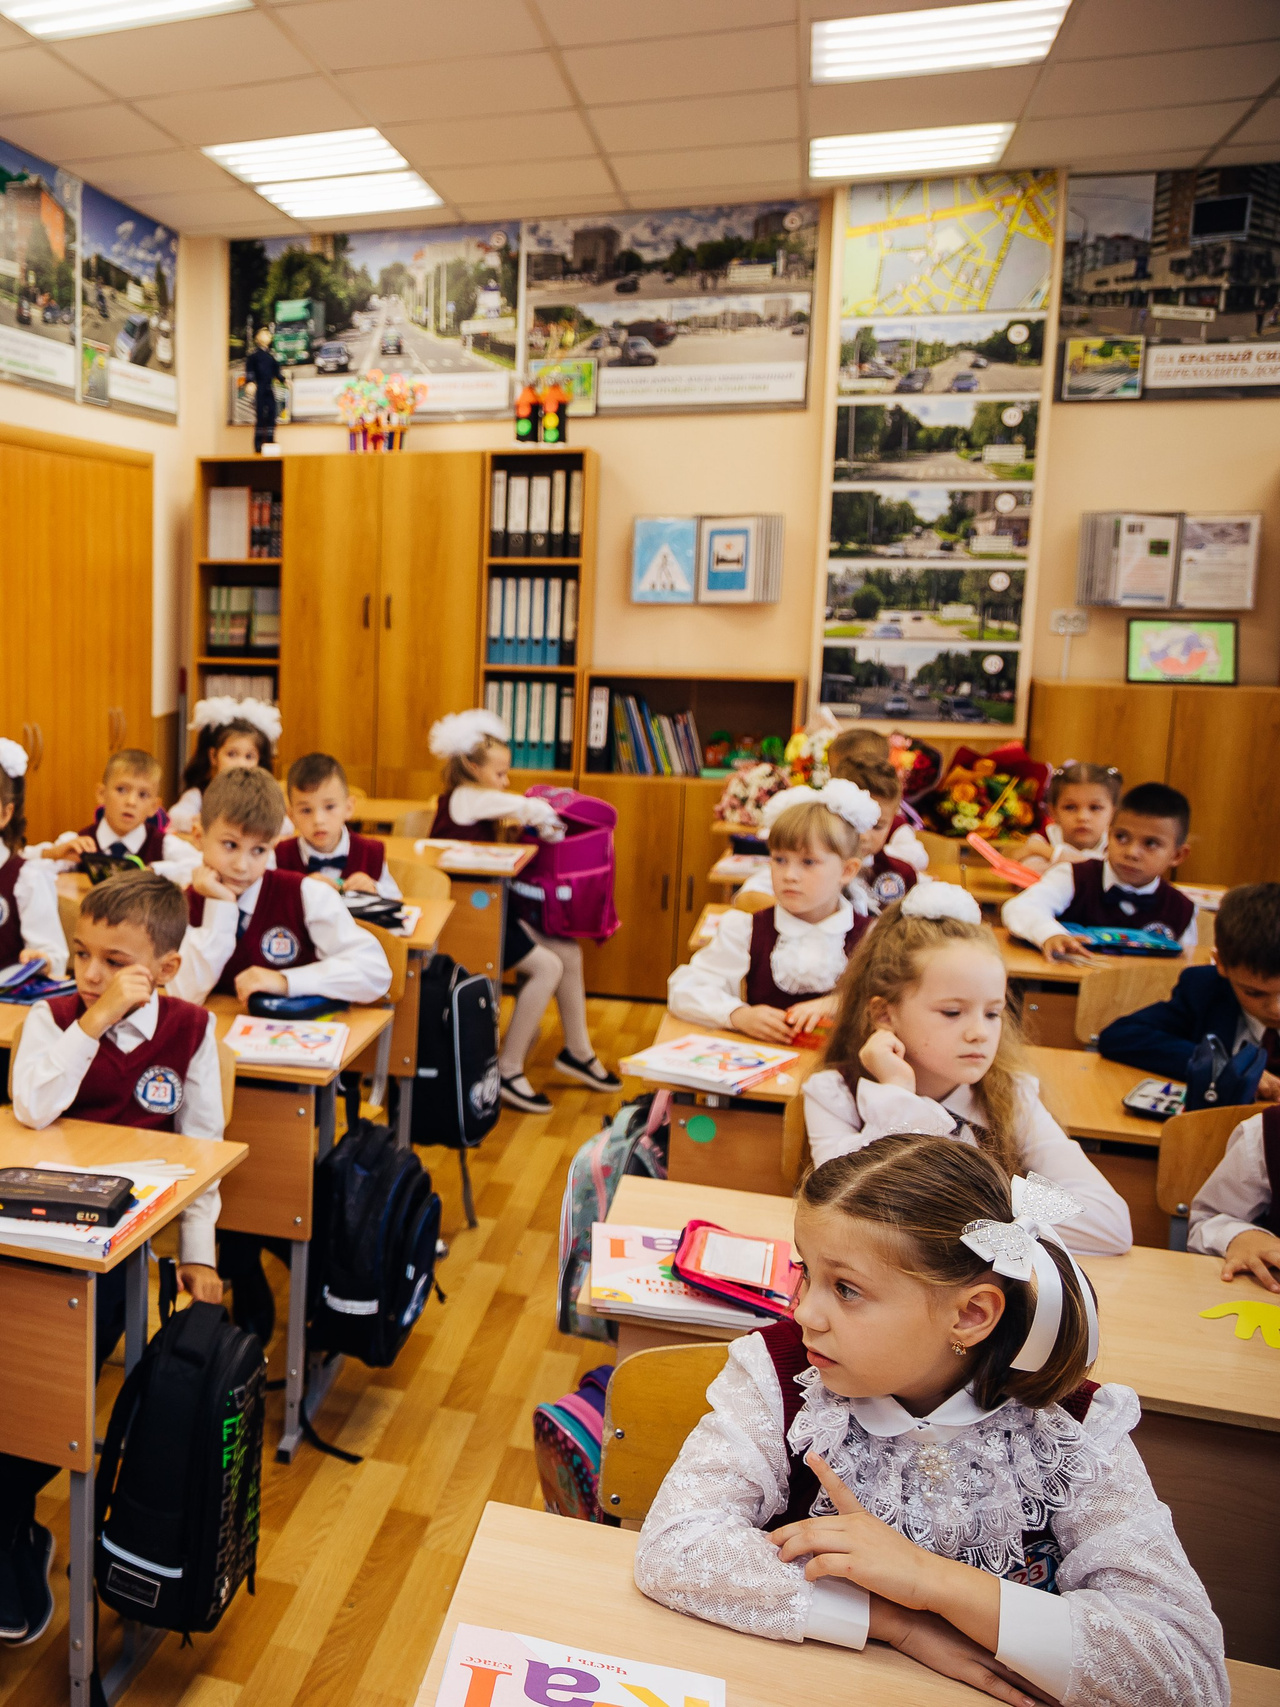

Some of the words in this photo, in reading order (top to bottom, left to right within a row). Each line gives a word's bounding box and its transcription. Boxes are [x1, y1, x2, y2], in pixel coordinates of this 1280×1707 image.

[1178, 348, 1253, 364] КРАСНЫЙ
[1013, 1564, 1044, 1586] 23
[464, 1655, 513, 1671] класс
[567, 1655, 573, 1663] 1
[580, 1657, 628, 1676] Часть
